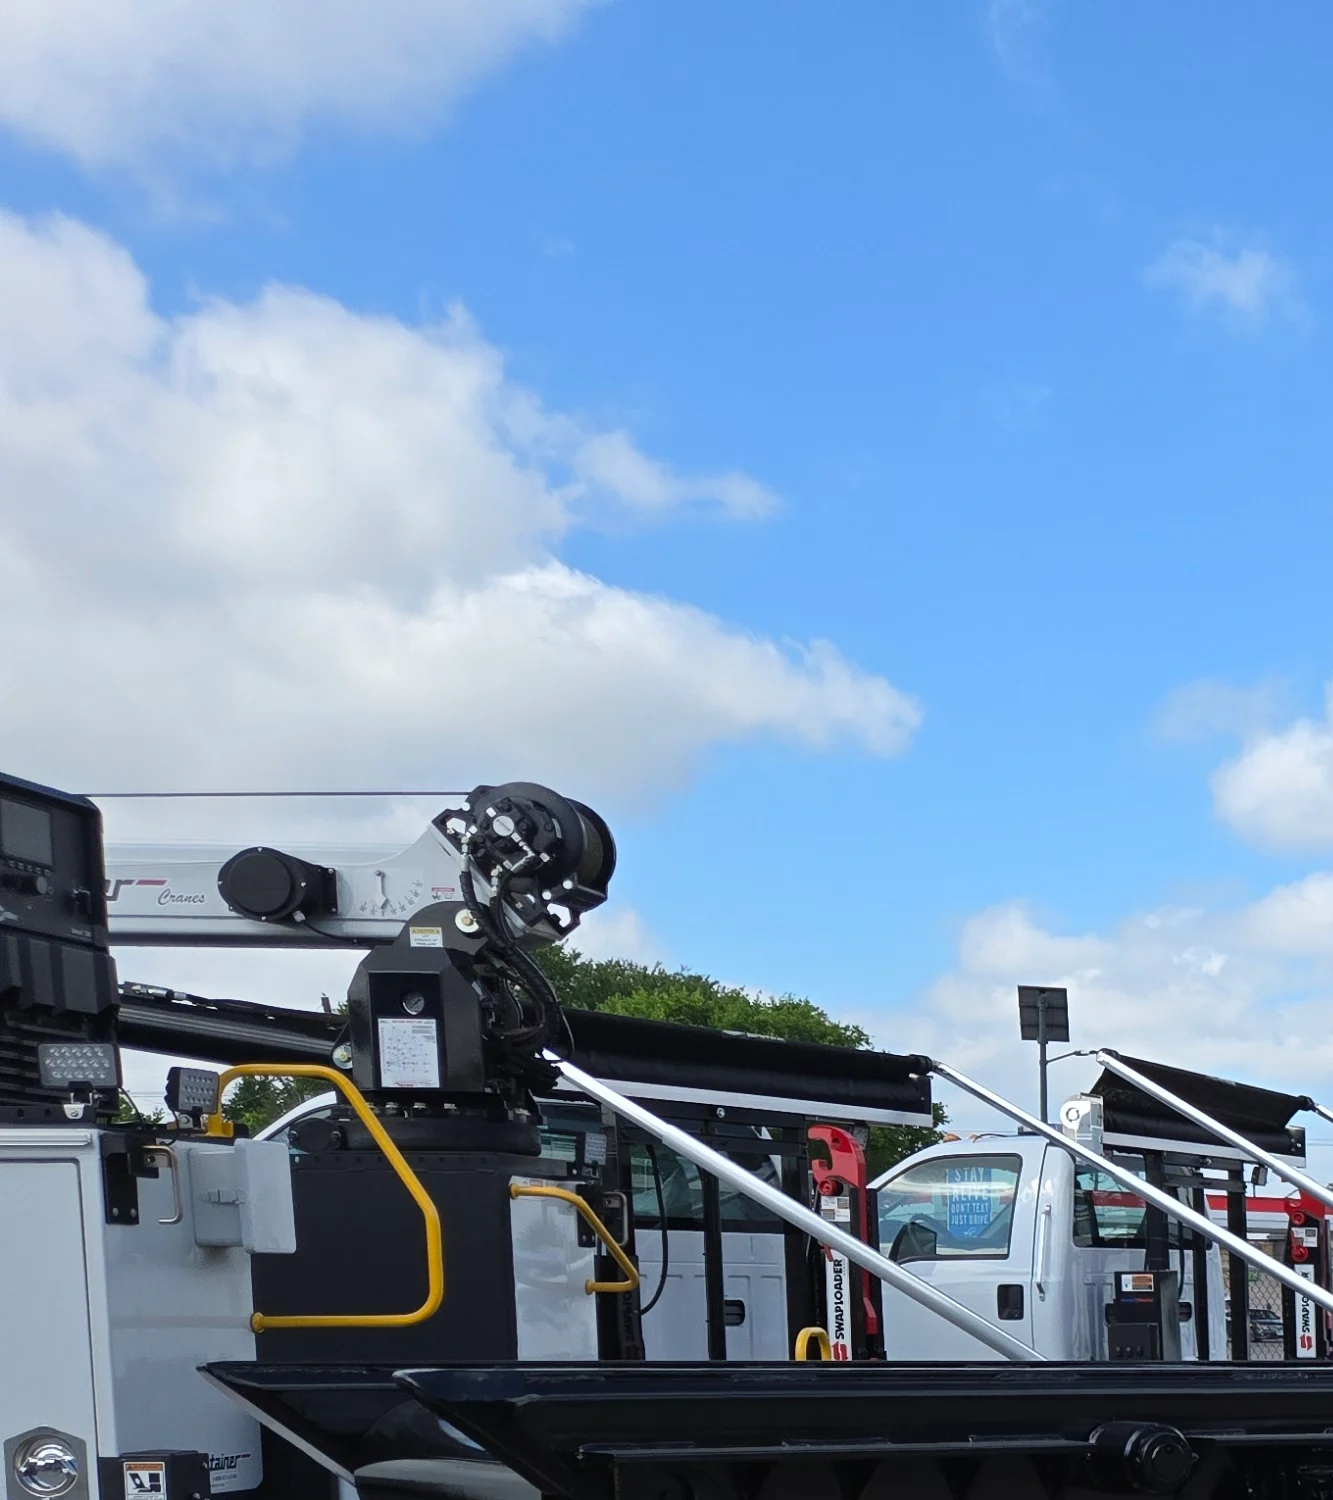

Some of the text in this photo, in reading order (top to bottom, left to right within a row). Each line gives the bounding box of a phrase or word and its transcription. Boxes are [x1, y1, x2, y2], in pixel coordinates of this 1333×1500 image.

[157, 888, 206, 906] Cranes
[954, 1167, 985, 1182] STAY
[950, 1203, 989, 1213] DON'T TEXT
[951, 1214, 989, 1225] JUST DRIVE
[833, 1258, 845, 1340] SWAPLOADER
